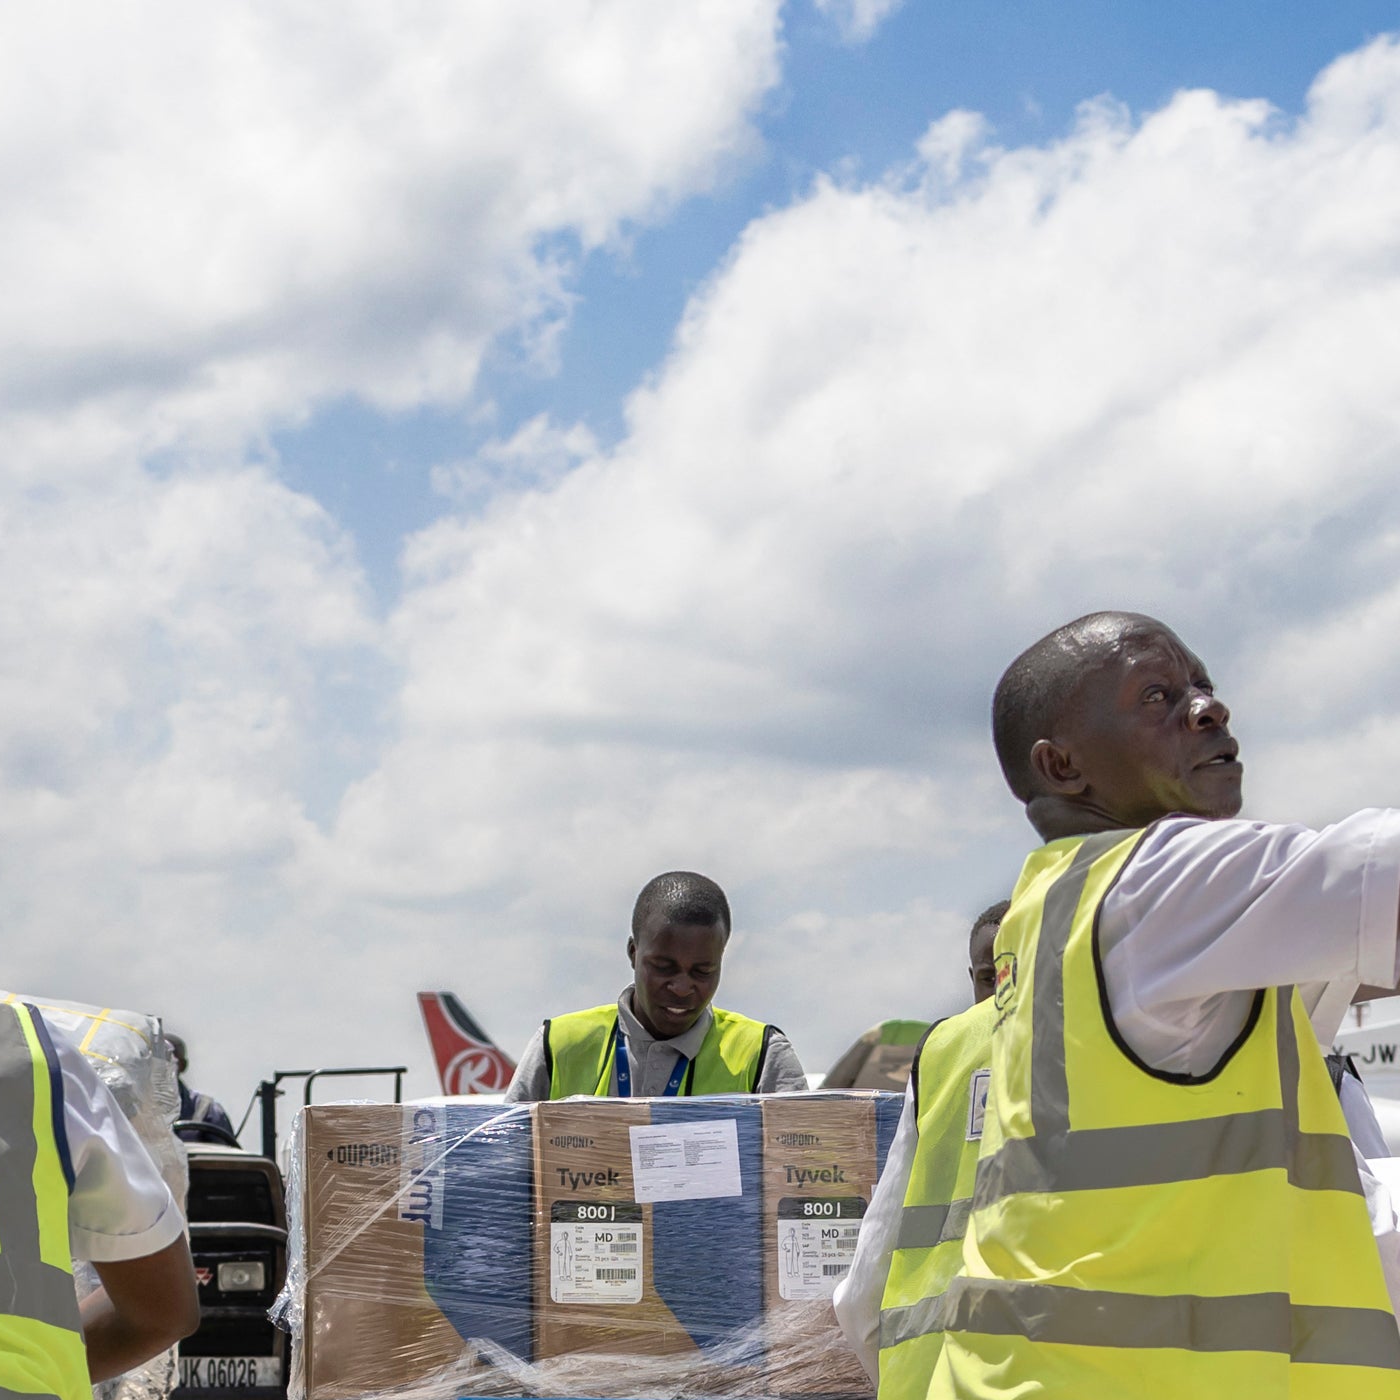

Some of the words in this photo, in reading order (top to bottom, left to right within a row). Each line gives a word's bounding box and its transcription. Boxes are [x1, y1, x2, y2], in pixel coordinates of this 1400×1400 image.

[555, 1135, 589, 1149] DUPONT
[780, 1133, 815, 1146] DUPONT
[556, 1167, 620, 1191] Tyvek
[783, 1164, 845, 1188] Tyvek
[577, 1206, 608, 1219] 800
[610, 1205, 616, 1221] J
[803, 1202, 834, 1216] 800
[836, 1202, 841, 1217] J
[594, 1232, 613, 1243] MD
[821, 1228, 839, 1239] MD
[207, 1358, 257, 1388] 06026
